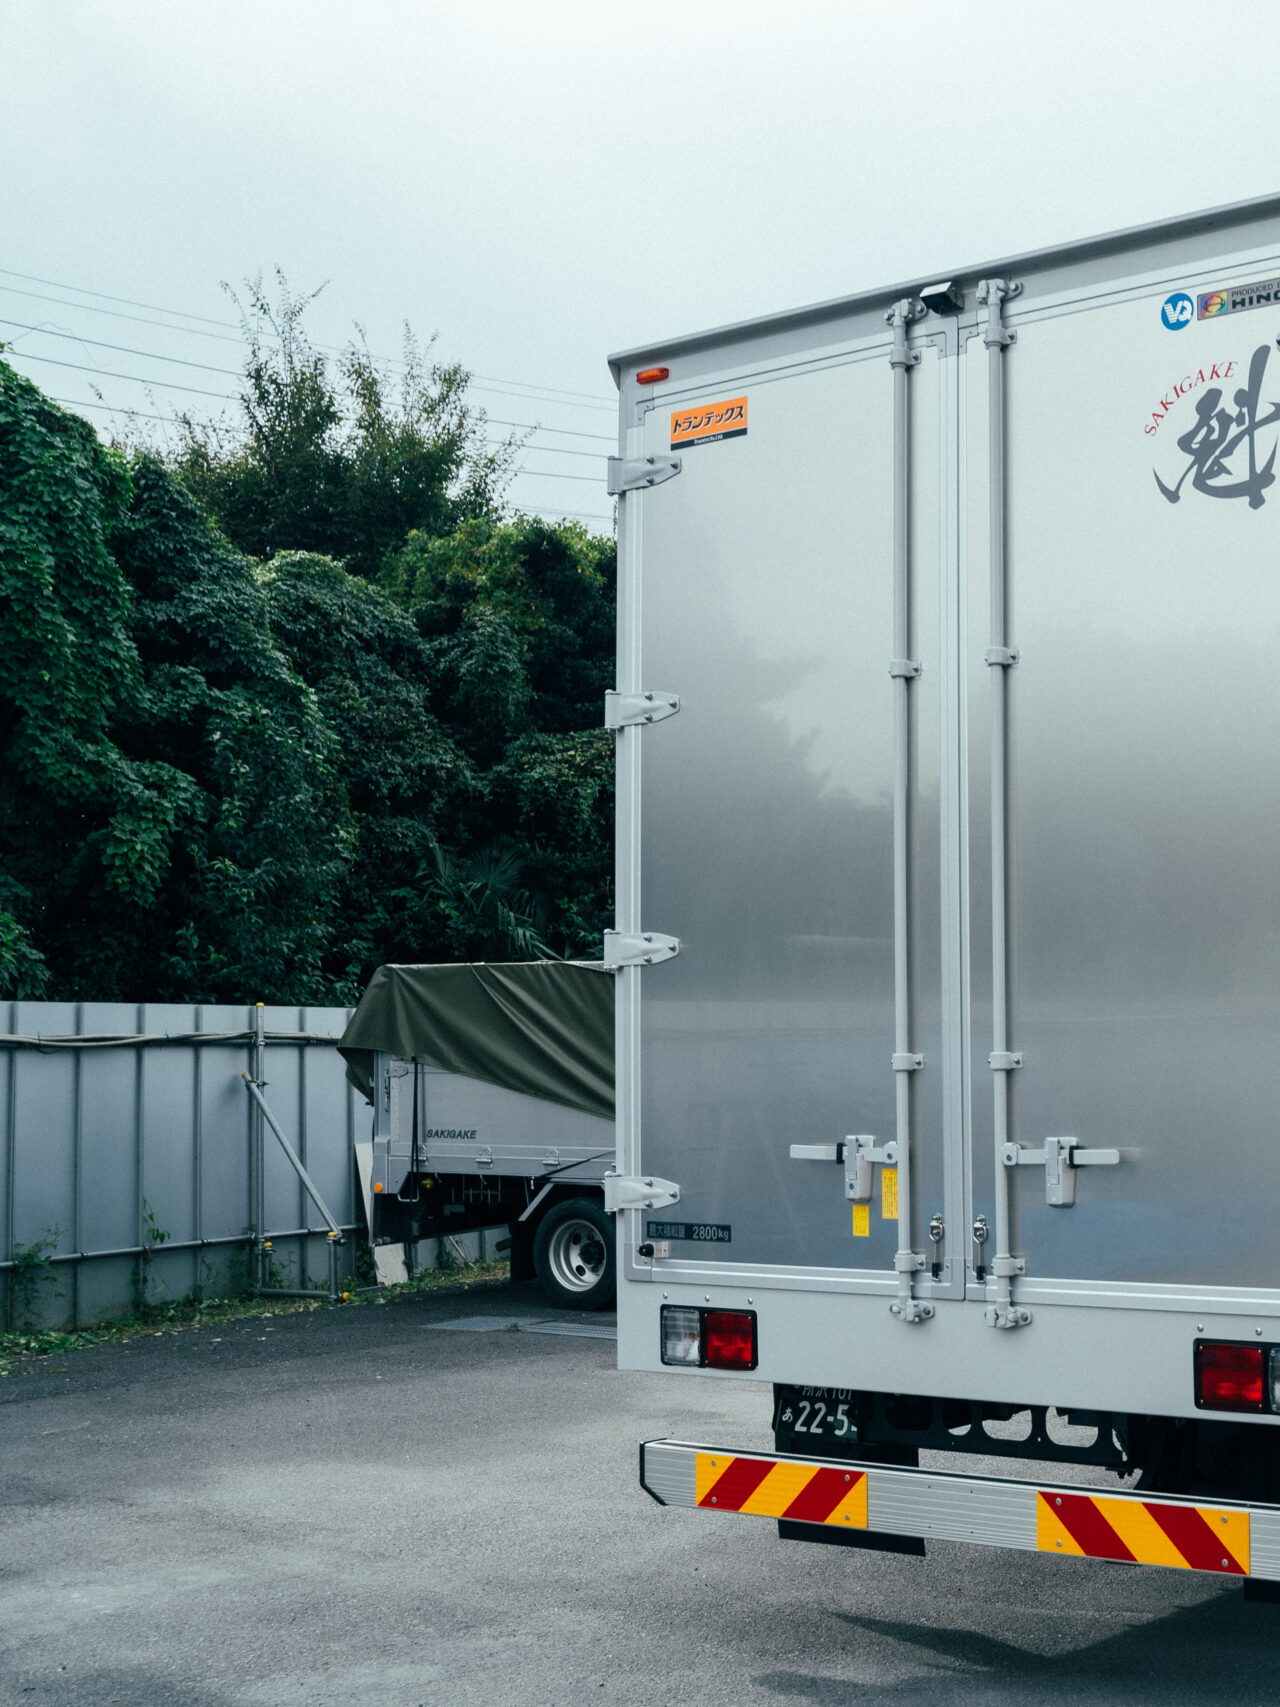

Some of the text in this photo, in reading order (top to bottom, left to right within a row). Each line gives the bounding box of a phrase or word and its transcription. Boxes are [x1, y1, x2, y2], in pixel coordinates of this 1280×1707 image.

[1231, 283, 1273, 297] PRODUCED
[1143, 361, 1239, 438] SAKIGAKE
[673, 404, 745, 435] トランテックス
[426, 1129, 477, 1140] SAKIGAKE
[781, 1400, 858, 1436] あ 22-5
